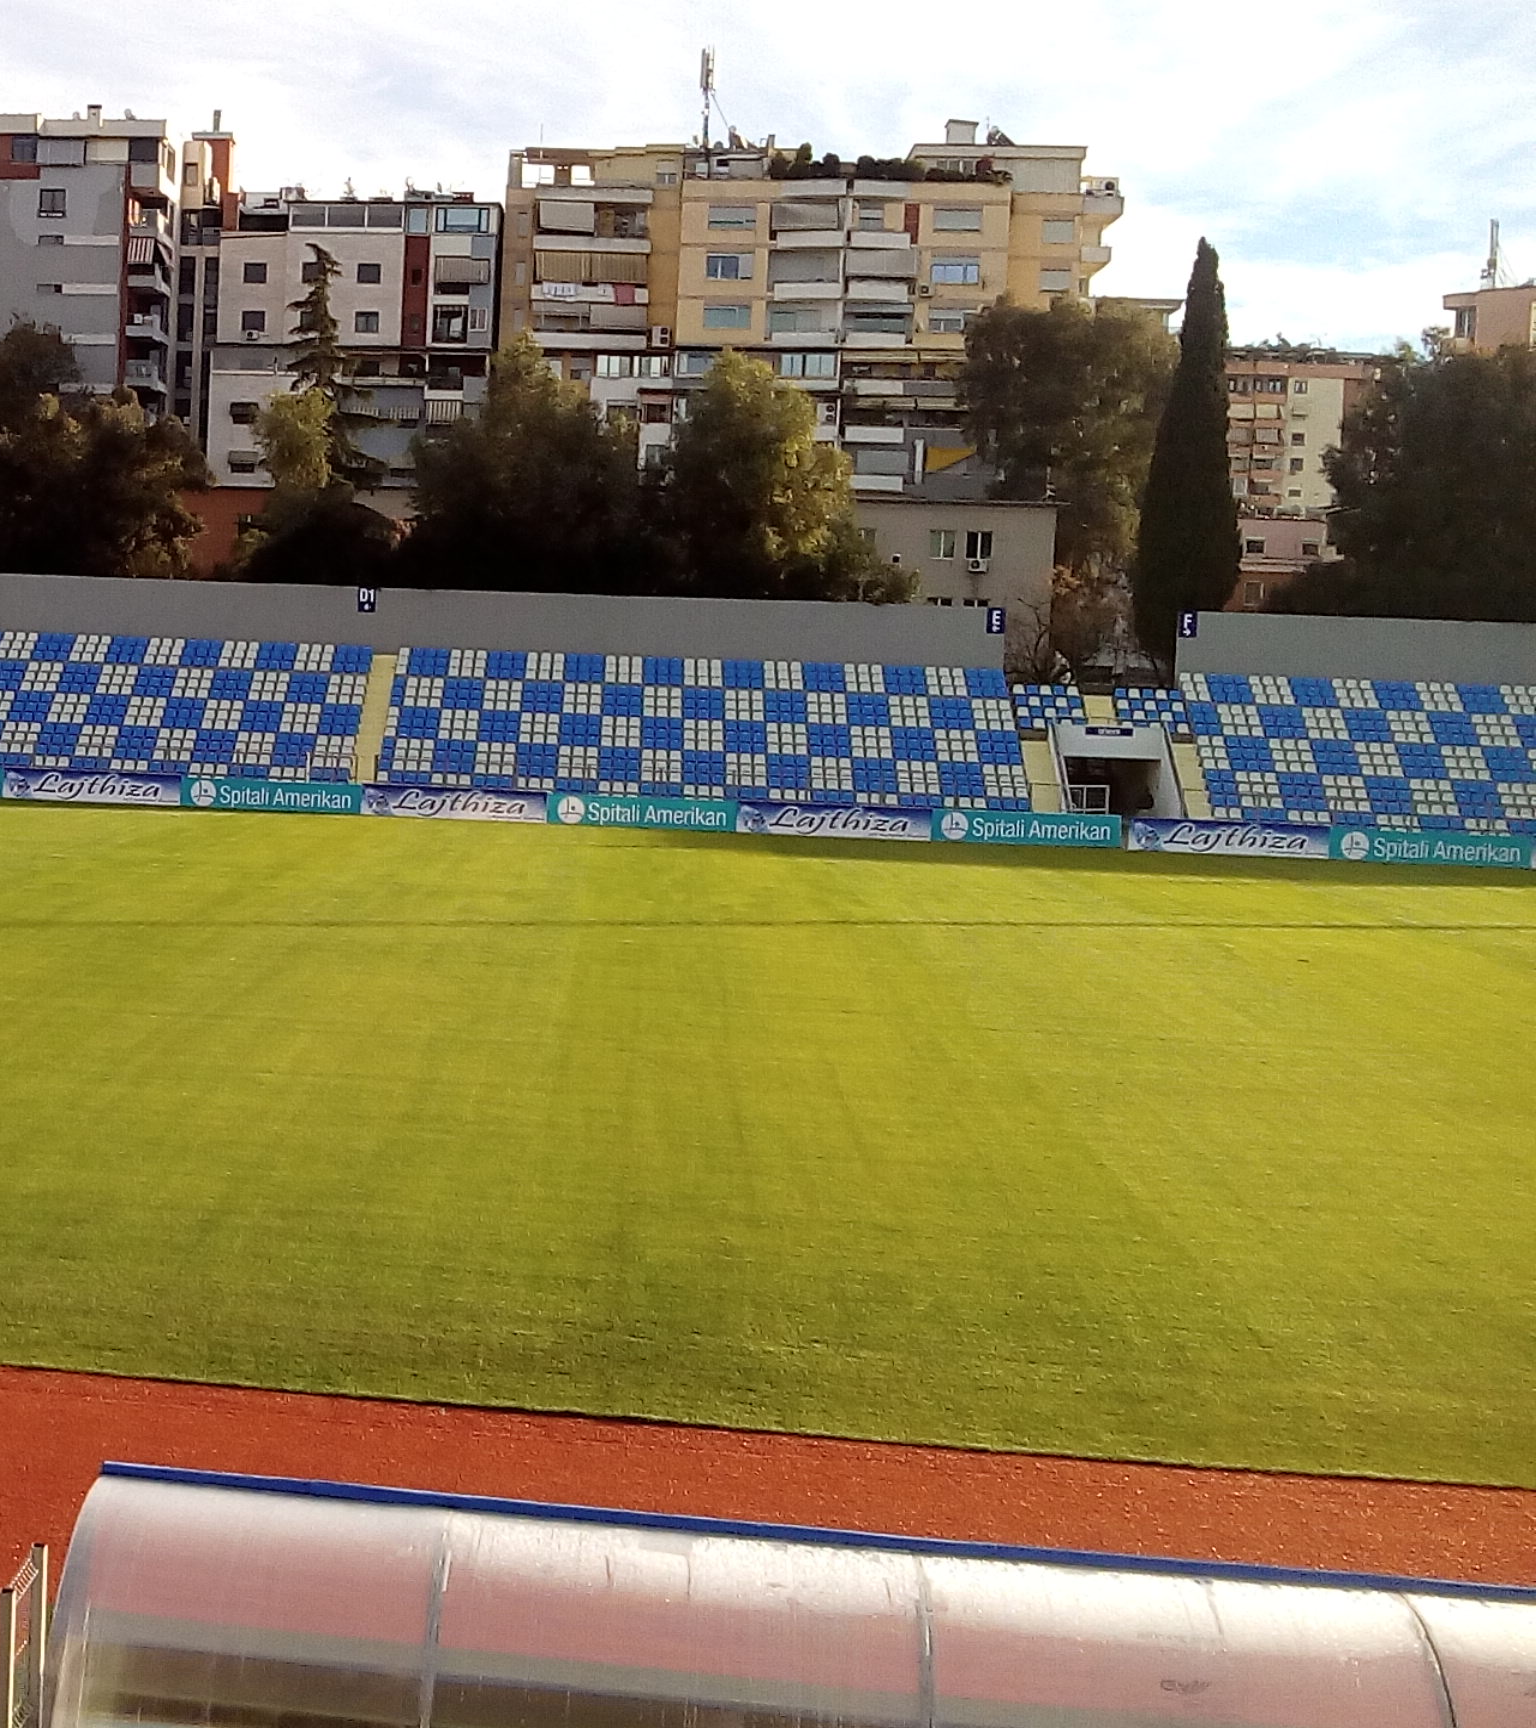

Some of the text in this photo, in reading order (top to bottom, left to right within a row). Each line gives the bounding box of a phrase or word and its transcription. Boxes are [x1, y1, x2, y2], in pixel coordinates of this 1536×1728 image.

[359, 588, 374, 602] D1
[992, 610, 1001, 625] E
[1184, 613, 1192, 628] F
[32, 773, 162, 800] Lajthiza
[219, 785, 352, 809] Spitali Amerikan
[392, 790, 527, 817] Lajthiza
[587, 801, 727, 826] Spitali Amerikan
[768, 806, 910, 834] Lajthiza
[972, 817, 1111, 841] Spitali Amerikan
[1163, 823, 1308, 852] Lajthiza
[1373, 837, 1520, 863] Spitali Amerikan
